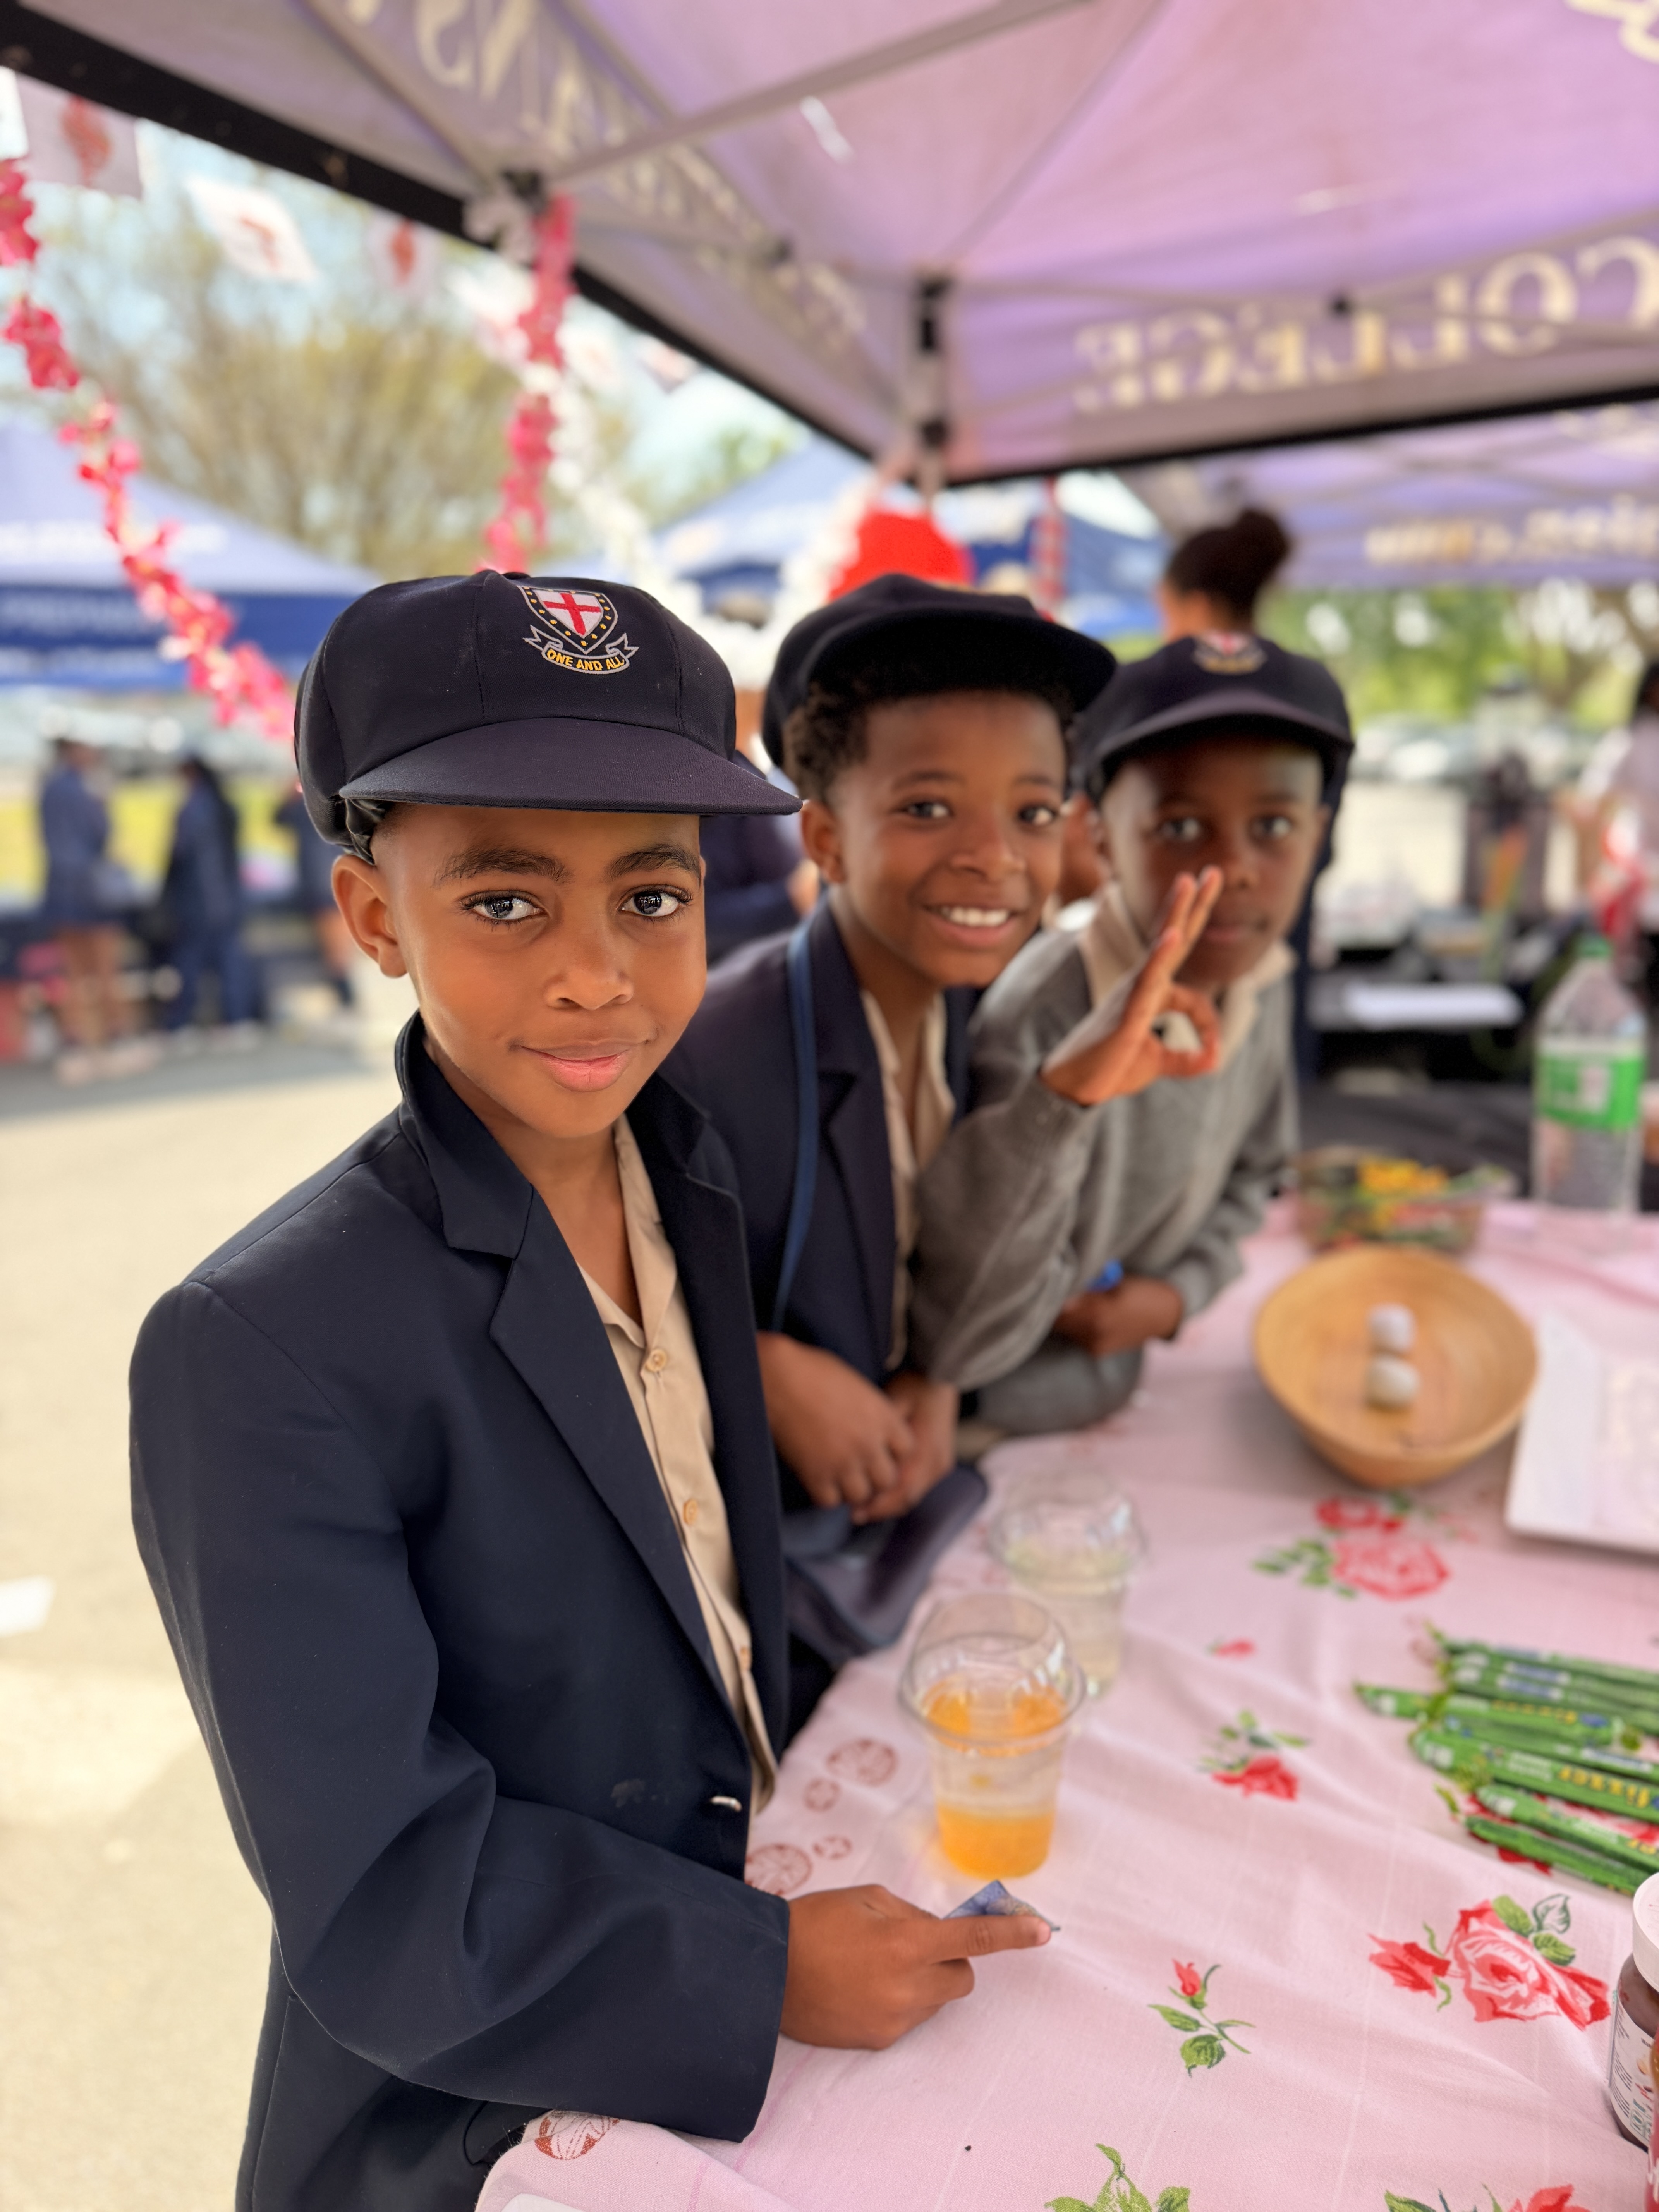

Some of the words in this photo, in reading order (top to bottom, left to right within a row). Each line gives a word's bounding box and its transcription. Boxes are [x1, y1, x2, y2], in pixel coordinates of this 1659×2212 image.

[547, 649, 573, 666] ONE
[576, 659, 603, 671] AND
[605, 656, 625, 670] ALL
